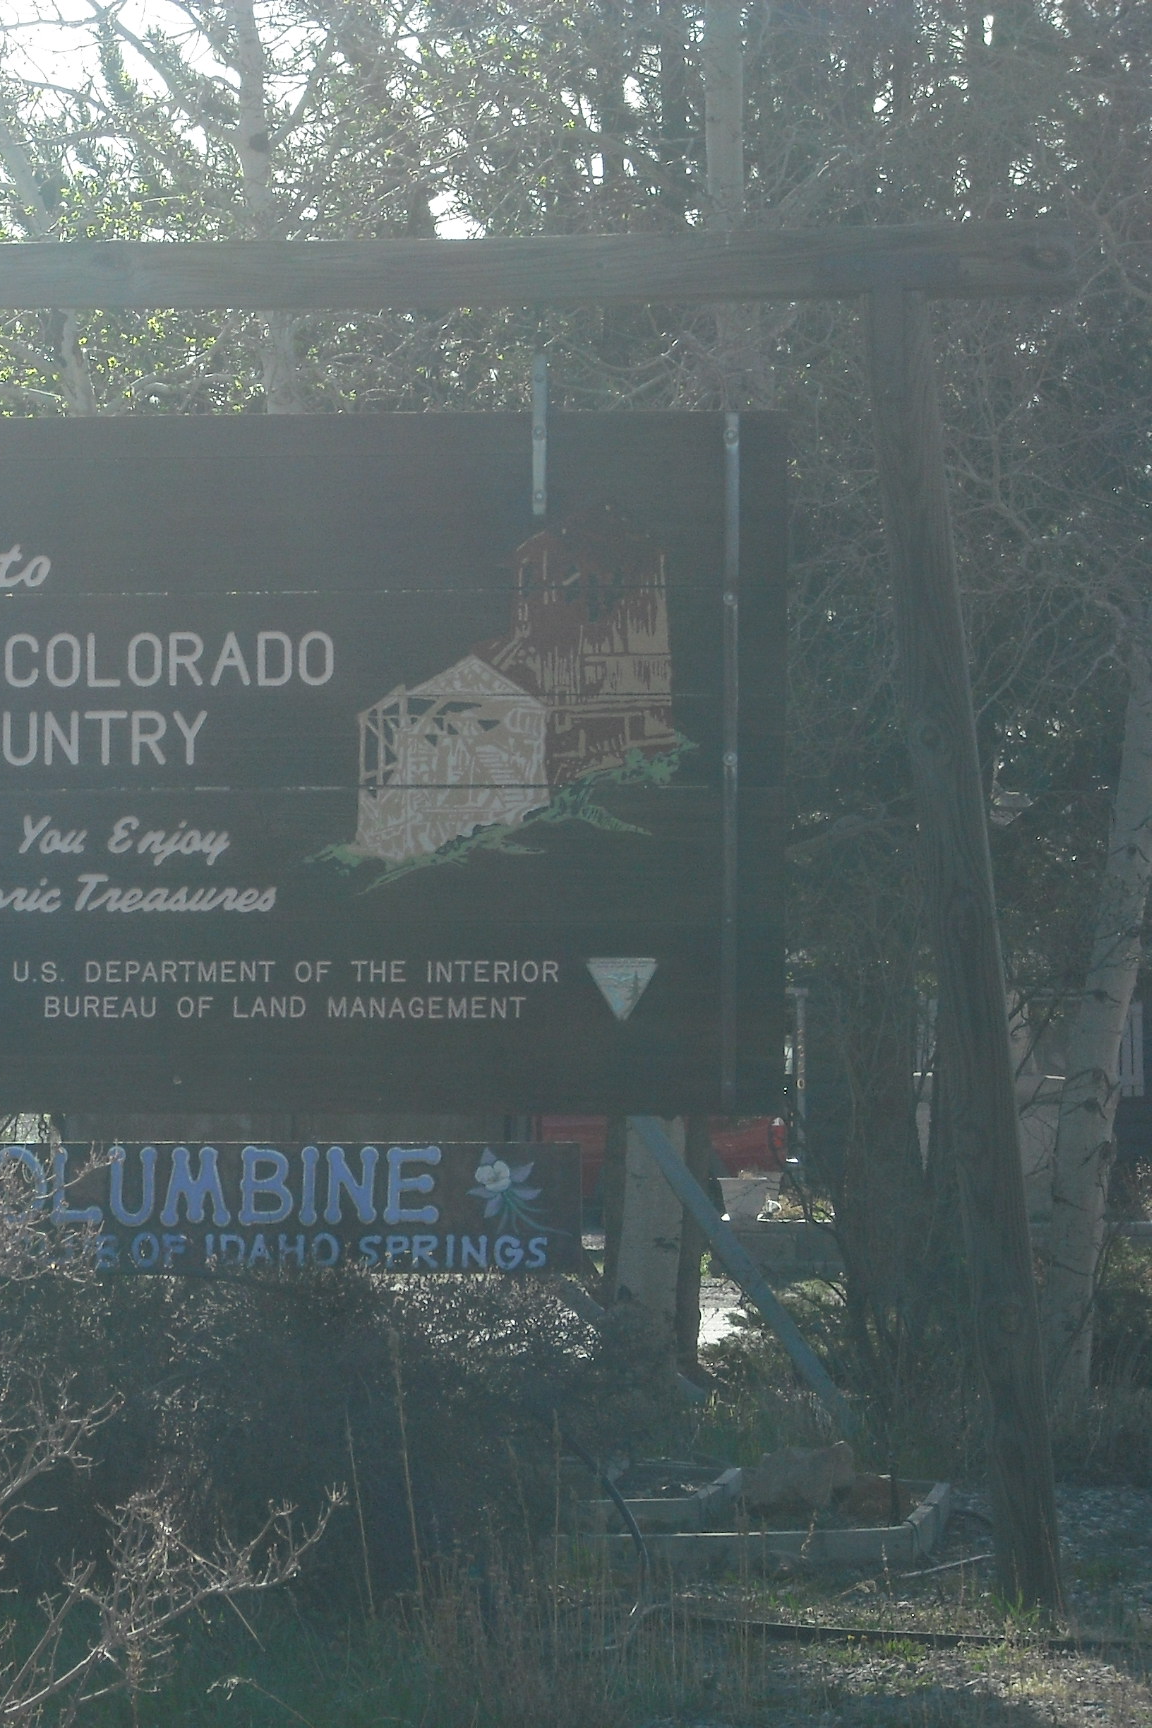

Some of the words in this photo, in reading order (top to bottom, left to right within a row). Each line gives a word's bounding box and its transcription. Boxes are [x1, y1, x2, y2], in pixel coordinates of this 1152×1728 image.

[5, 631, 334, 688] COLORADO
[19, 815, 87, 854] You
[108, 816, 230, 866] Enjoy
[75, 874, 276, 913] Treasures
[13, 961, 66, 983] U.S.
[85, 960, 275, 983] DEPARTMENT
[294, 961, 332, 983] OF
[351, 960, 406, 983] THE
[427, 960, 558, 983] INTERIOR
[44, 995, 156, 1018] BUREAU
[177, 996, 213, 1018] OF
[233, 995, 306, 1018] LAND
[328, 996, 526, 1019] MANAGEMENT
[130, 1232, 186, 1268] OF
[205, 1232, 340, 1267] IDAHO
[358, 1234, 548, 1270] SPRINGS
